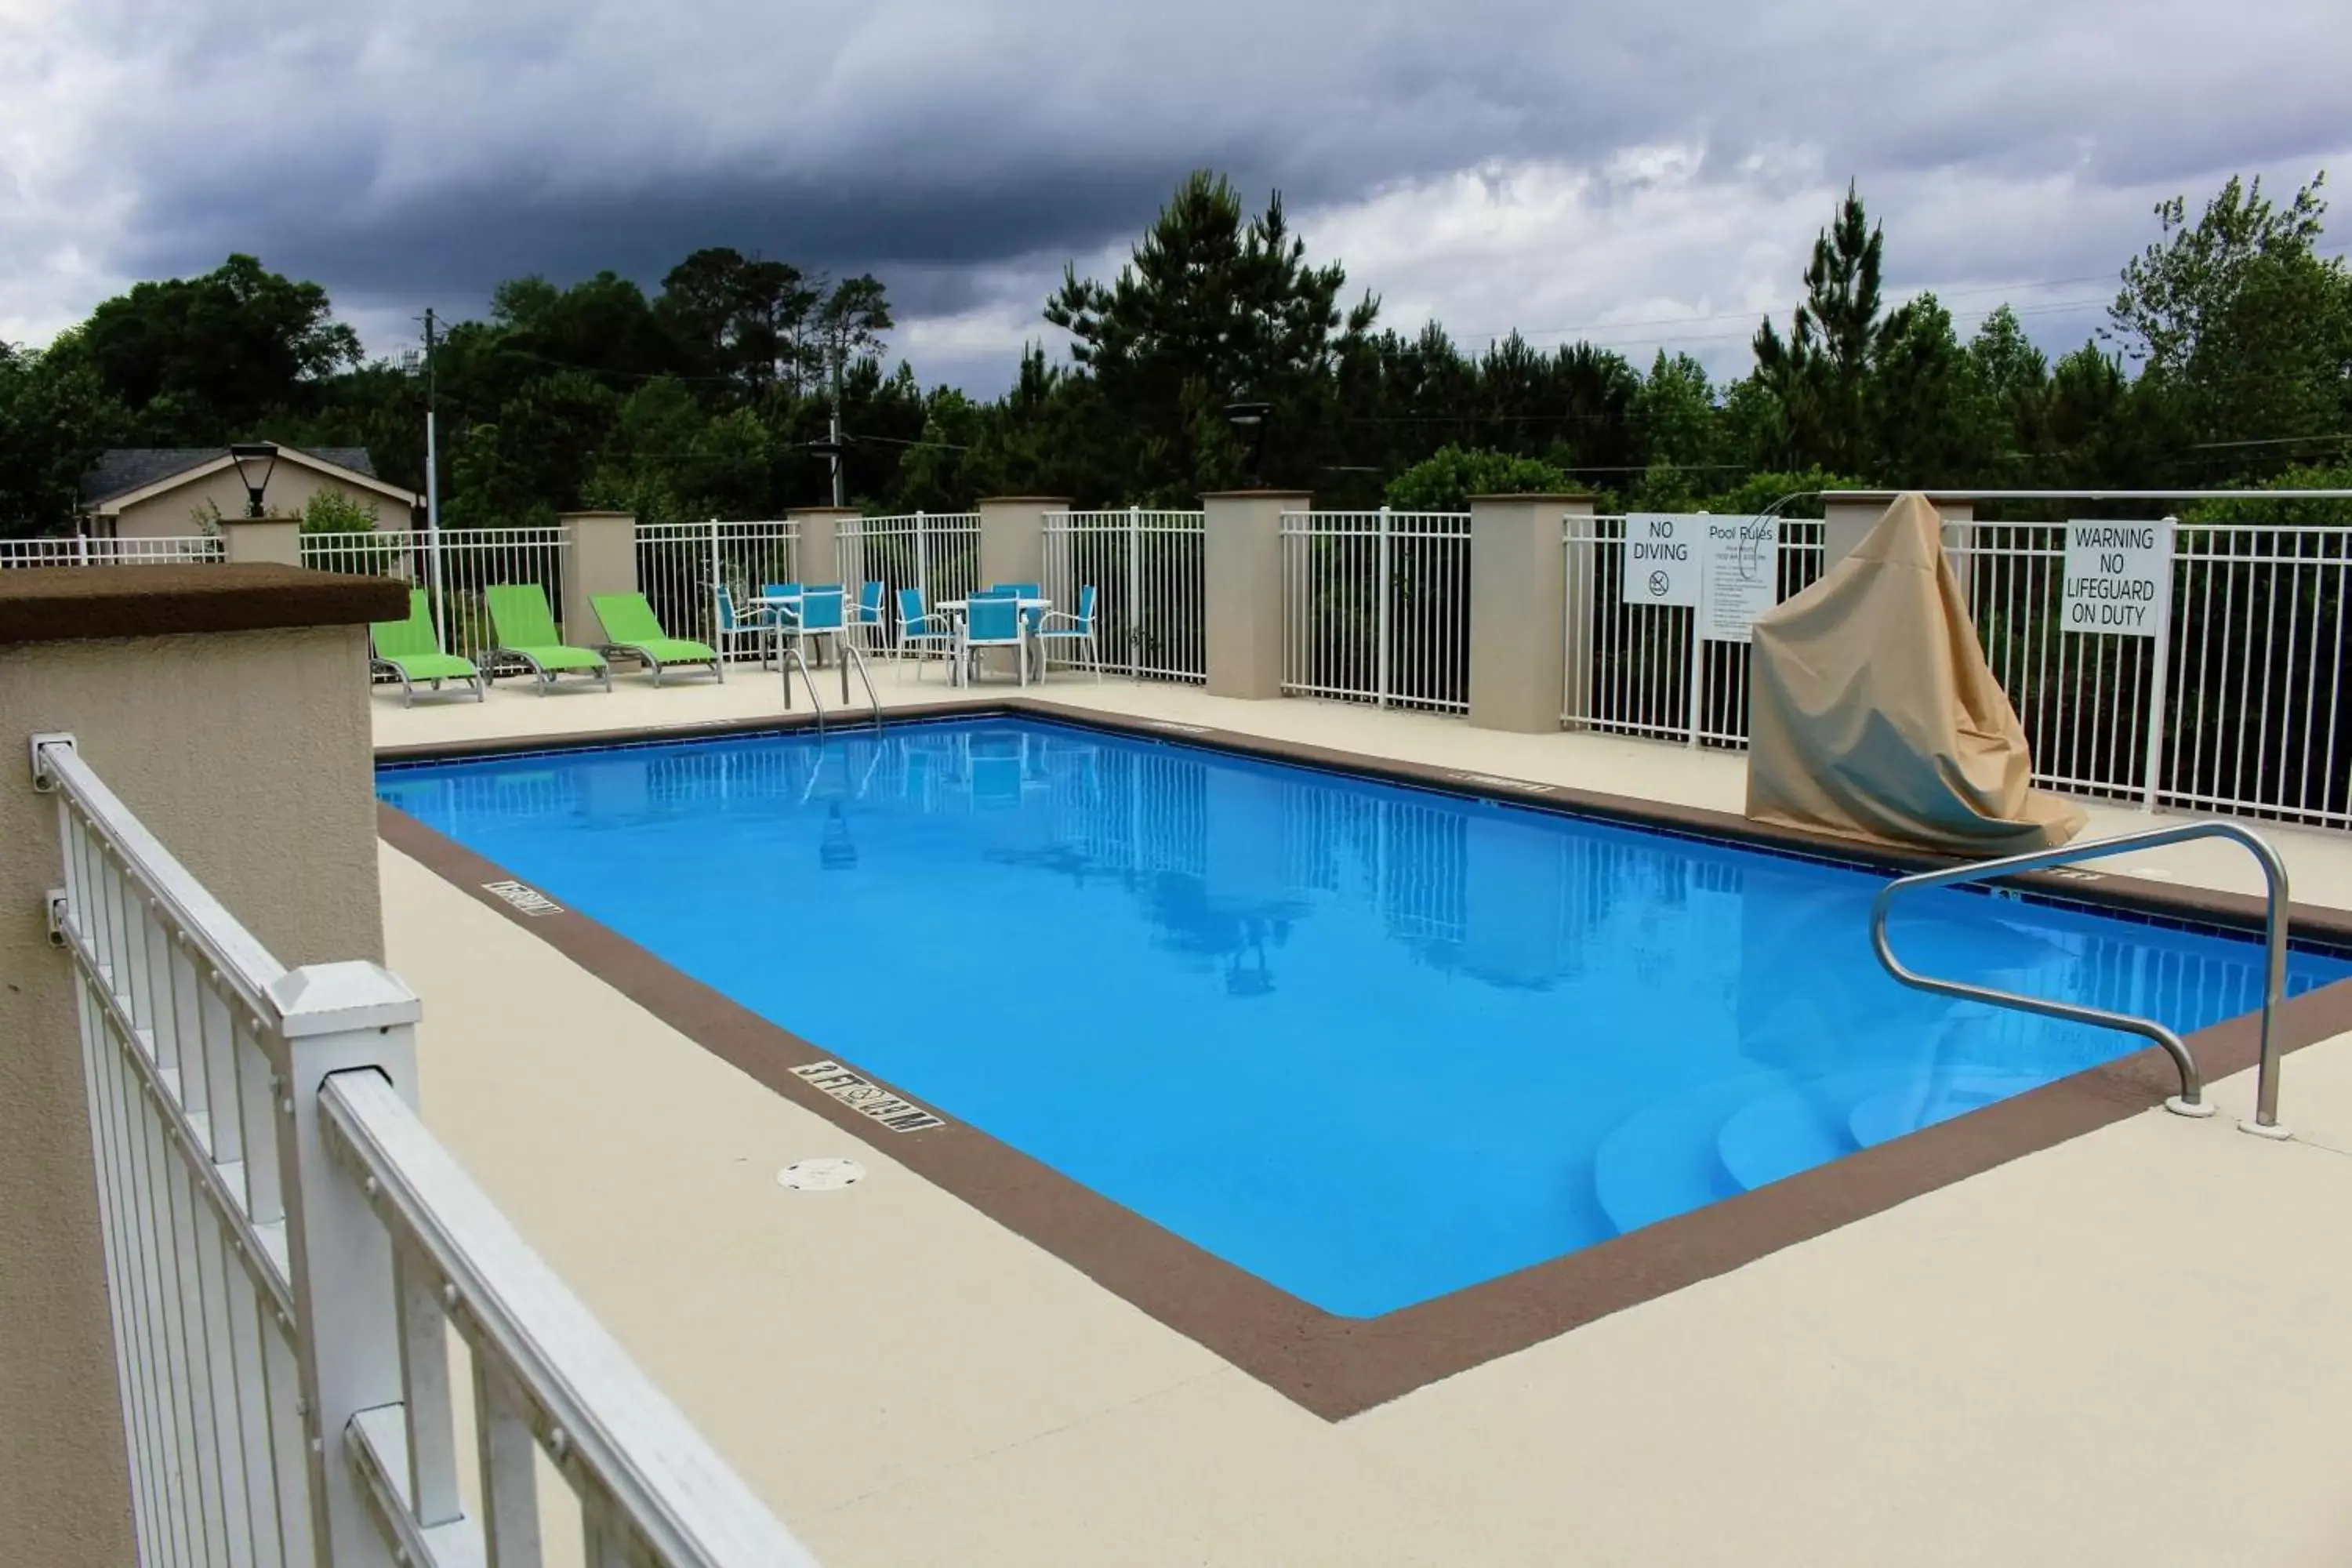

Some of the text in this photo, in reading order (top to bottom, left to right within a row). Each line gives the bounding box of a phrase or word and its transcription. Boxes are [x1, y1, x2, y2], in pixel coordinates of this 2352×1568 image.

[1650, 521, 1673, 539] NO
[1709, 525, 1773, 540] Pool Rules
[2075, 528, 2154, 550] WARNING
[1634, 543, 1688, 561] DIVING
[2100, 554, 2124, 574] NO
[2067, 578, 2154, 601] LIFEGUARD
[2072, 603, 2146, 626] ON DUTY
